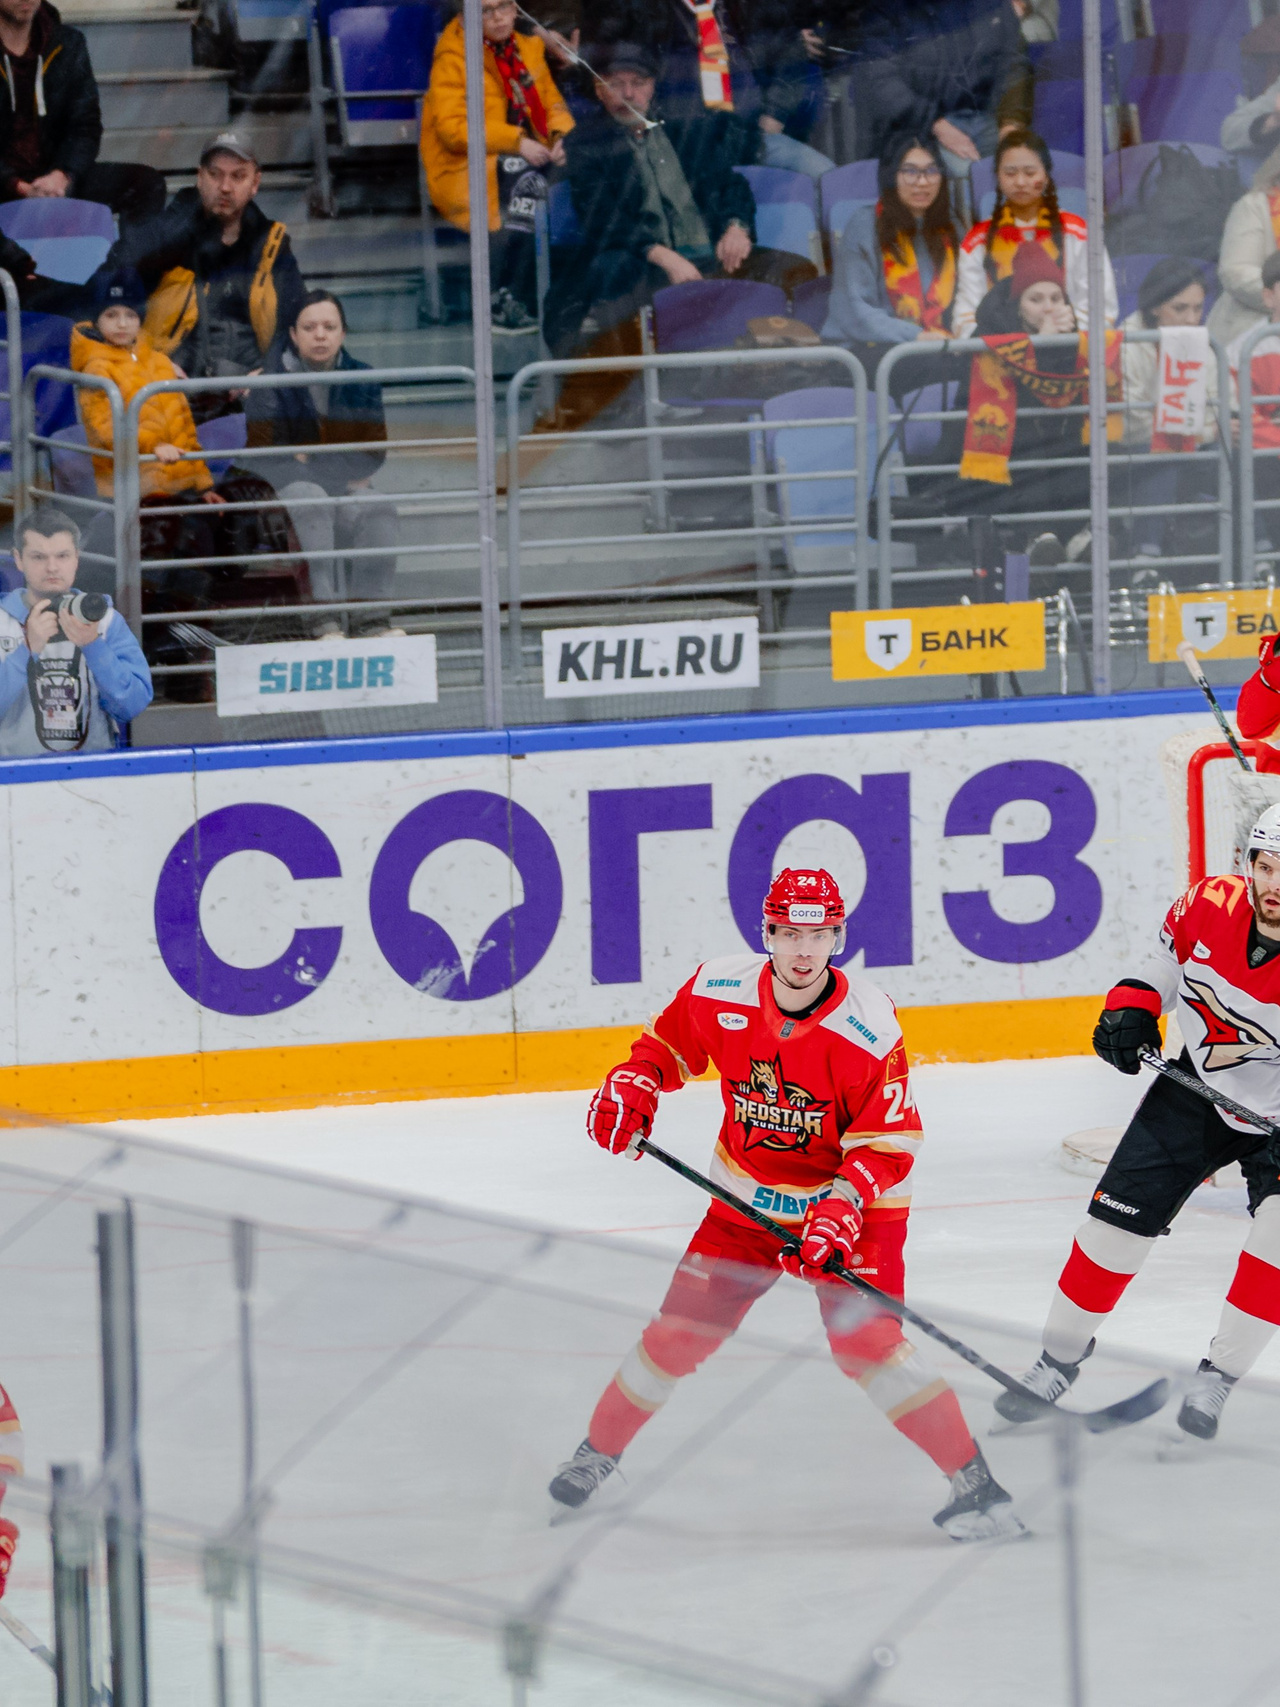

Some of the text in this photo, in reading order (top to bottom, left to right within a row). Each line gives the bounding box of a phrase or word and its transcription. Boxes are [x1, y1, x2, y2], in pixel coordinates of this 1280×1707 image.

[920, 626, 1010, 653] БАНК
[557, 632, 745, 683] KHL.RU
[259, 654, 396, 696] SIBUR
[153, 759, 1104, 1016] согаз
[796, 875, 818, 887] 24
[790, 907, 824, 919] согаз
[706, 978, 742, 988] SIBUR
[846, 1015, 878, 1045] SIBUR
[732, 1093, 828, 1140] REDSTAR
[883, 1078, 917, 1125] 24
[751, 1185, 832, 1215] SIBU
